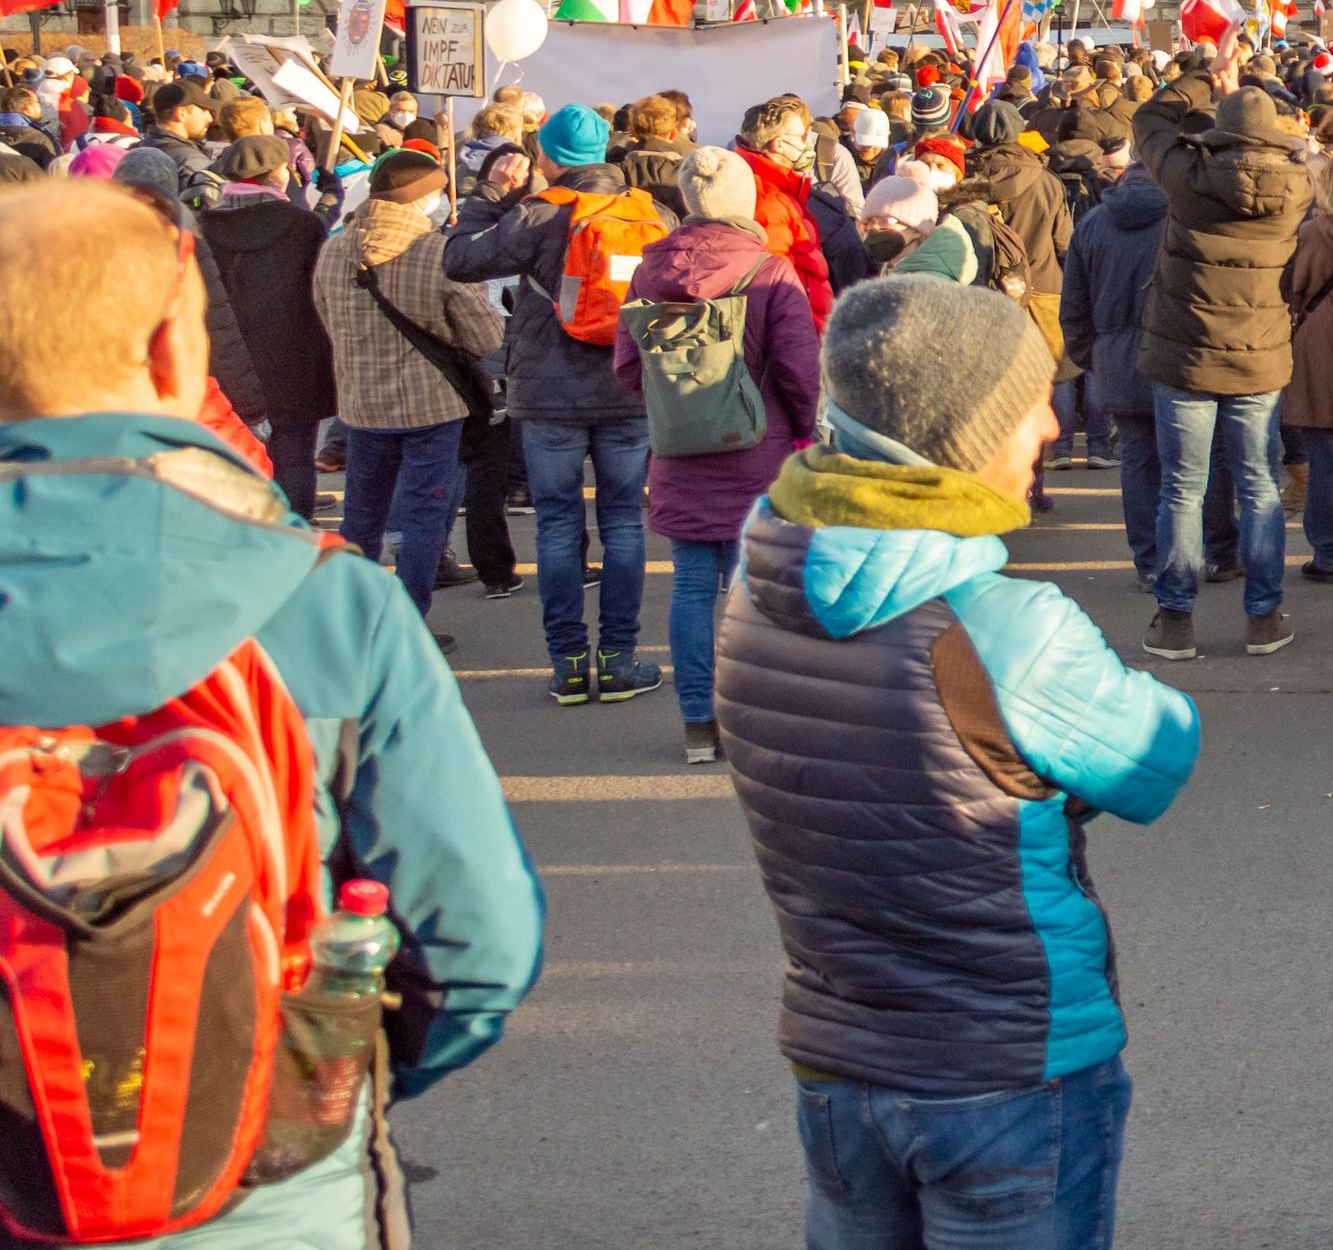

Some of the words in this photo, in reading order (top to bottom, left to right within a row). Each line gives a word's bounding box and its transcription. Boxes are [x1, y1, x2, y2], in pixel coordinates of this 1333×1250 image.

[422, 17, 447, 35] NEIN
[451, 22, 469, 33] ZUR
[423, 40, 458, 62] IMPF
